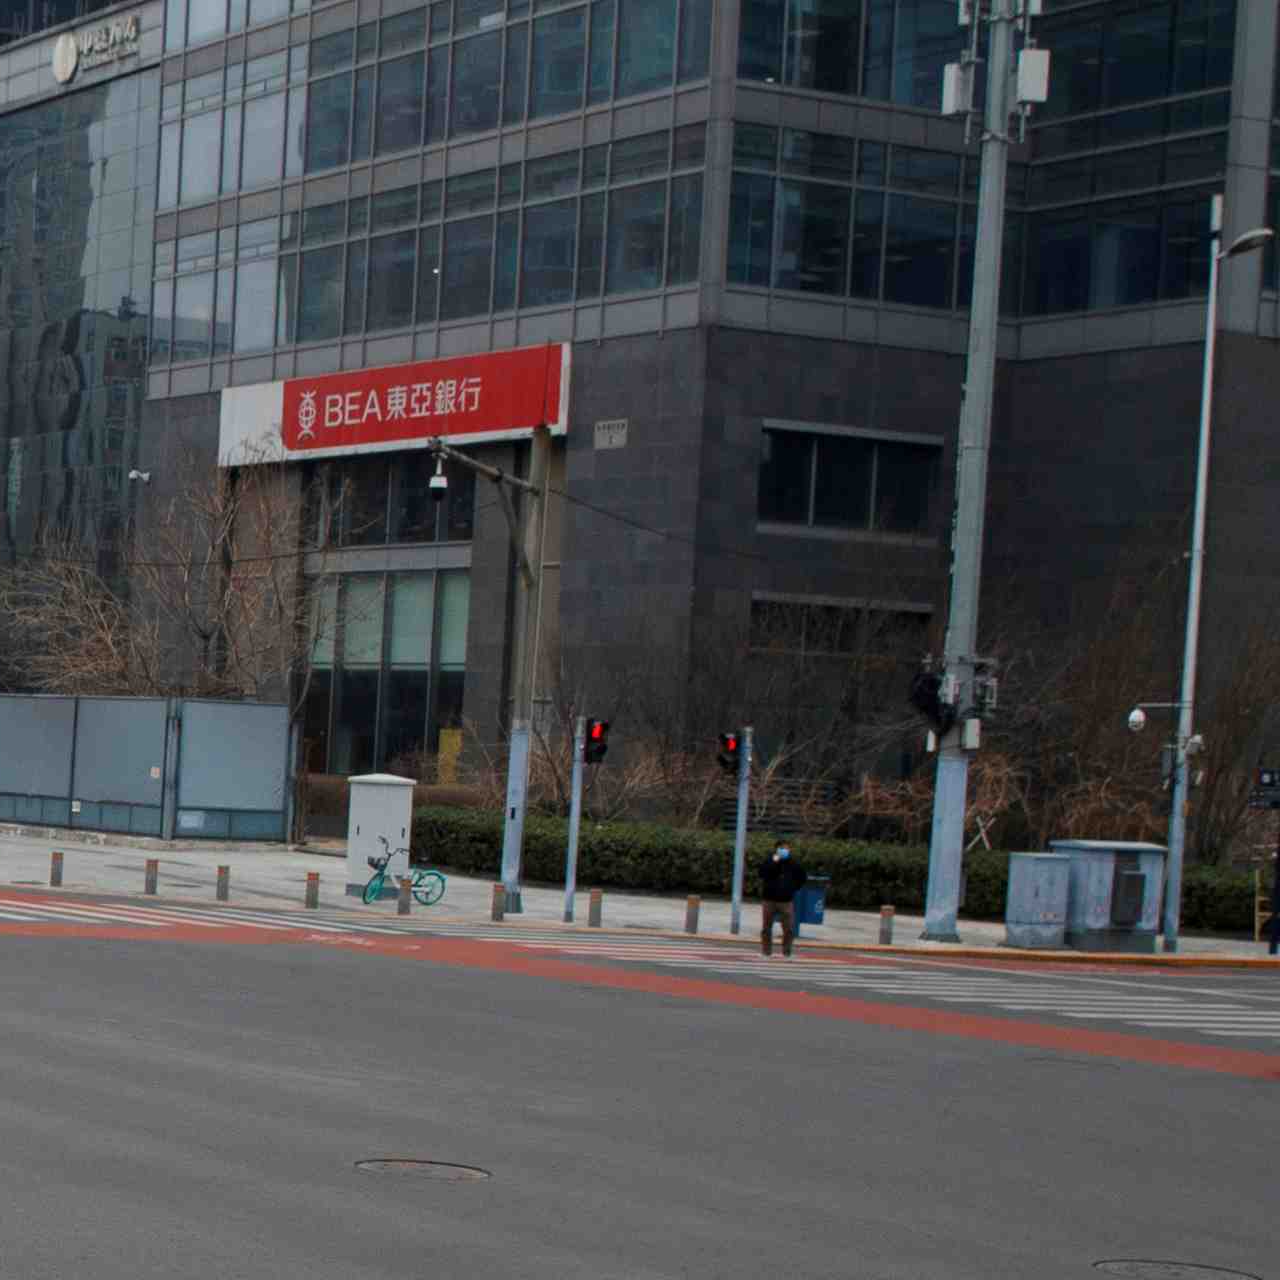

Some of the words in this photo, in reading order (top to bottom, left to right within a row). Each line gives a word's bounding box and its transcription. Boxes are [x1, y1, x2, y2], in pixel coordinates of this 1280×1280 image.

[324, 389, 382, 427] BEA
[385, 377, 481, 421] 東亞銀行
